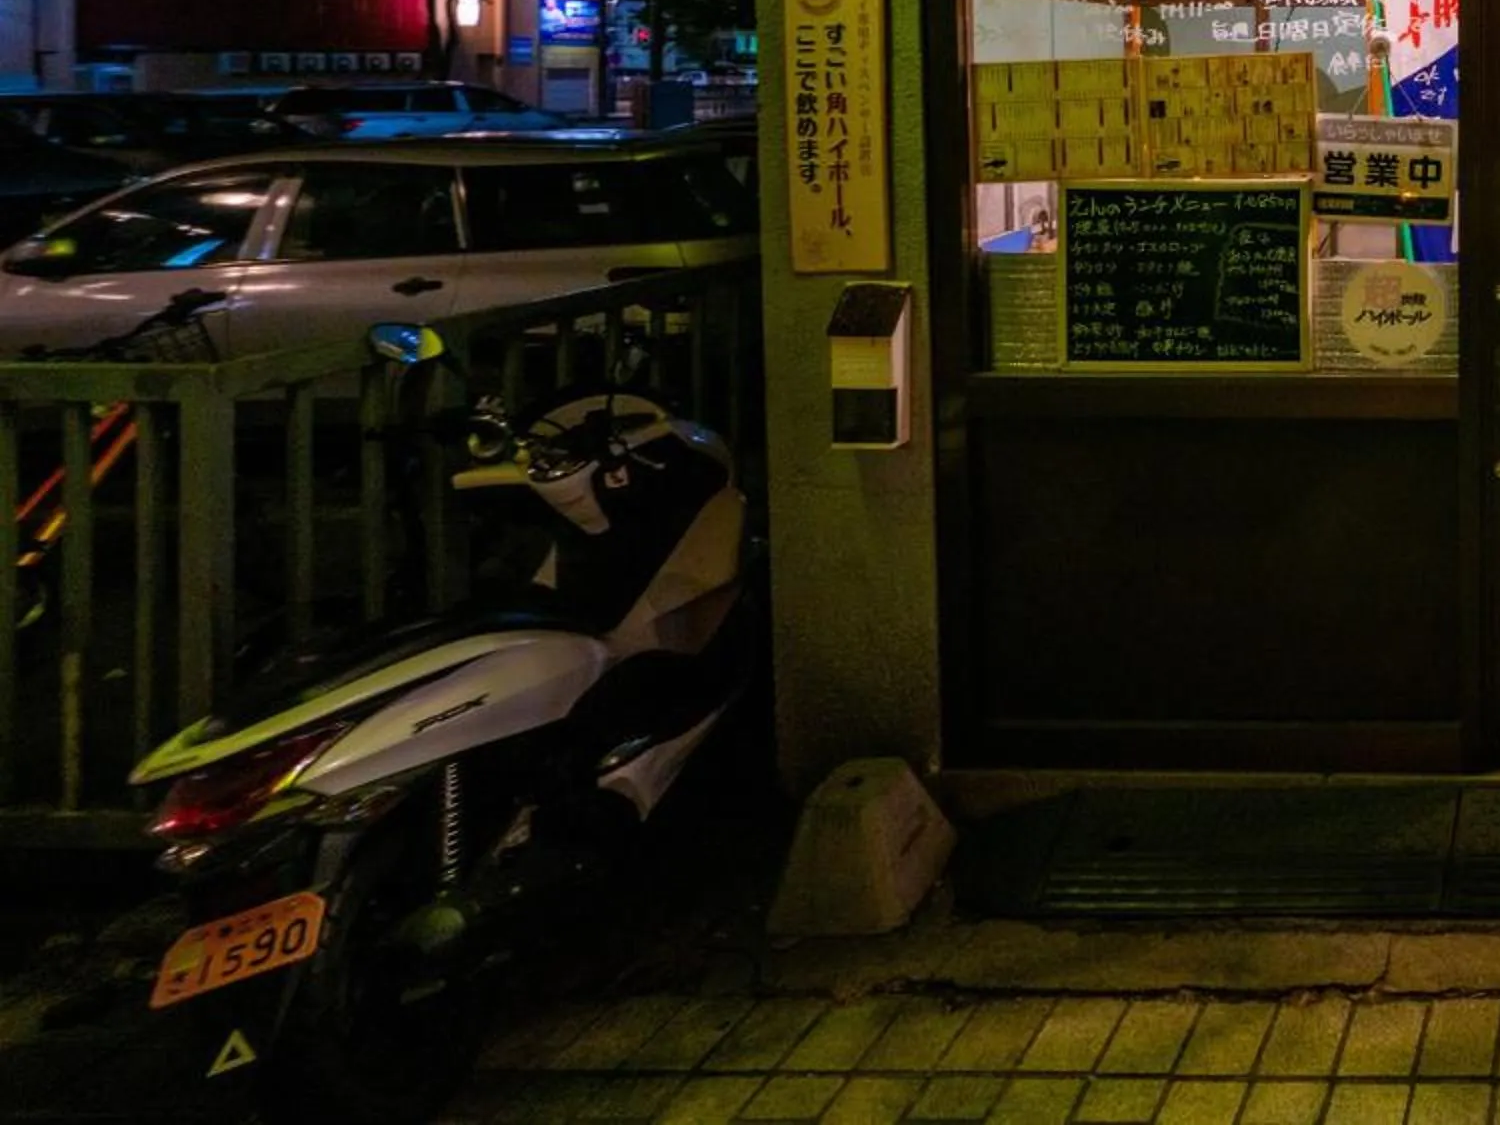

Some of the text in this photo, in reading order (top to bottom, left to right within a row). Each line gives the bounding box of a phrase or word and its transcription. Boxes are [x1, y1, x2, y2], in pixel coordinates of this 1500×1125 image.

[1323, 150, 1442, 189] 営業中
[197, 917, 307, 986] 1590
